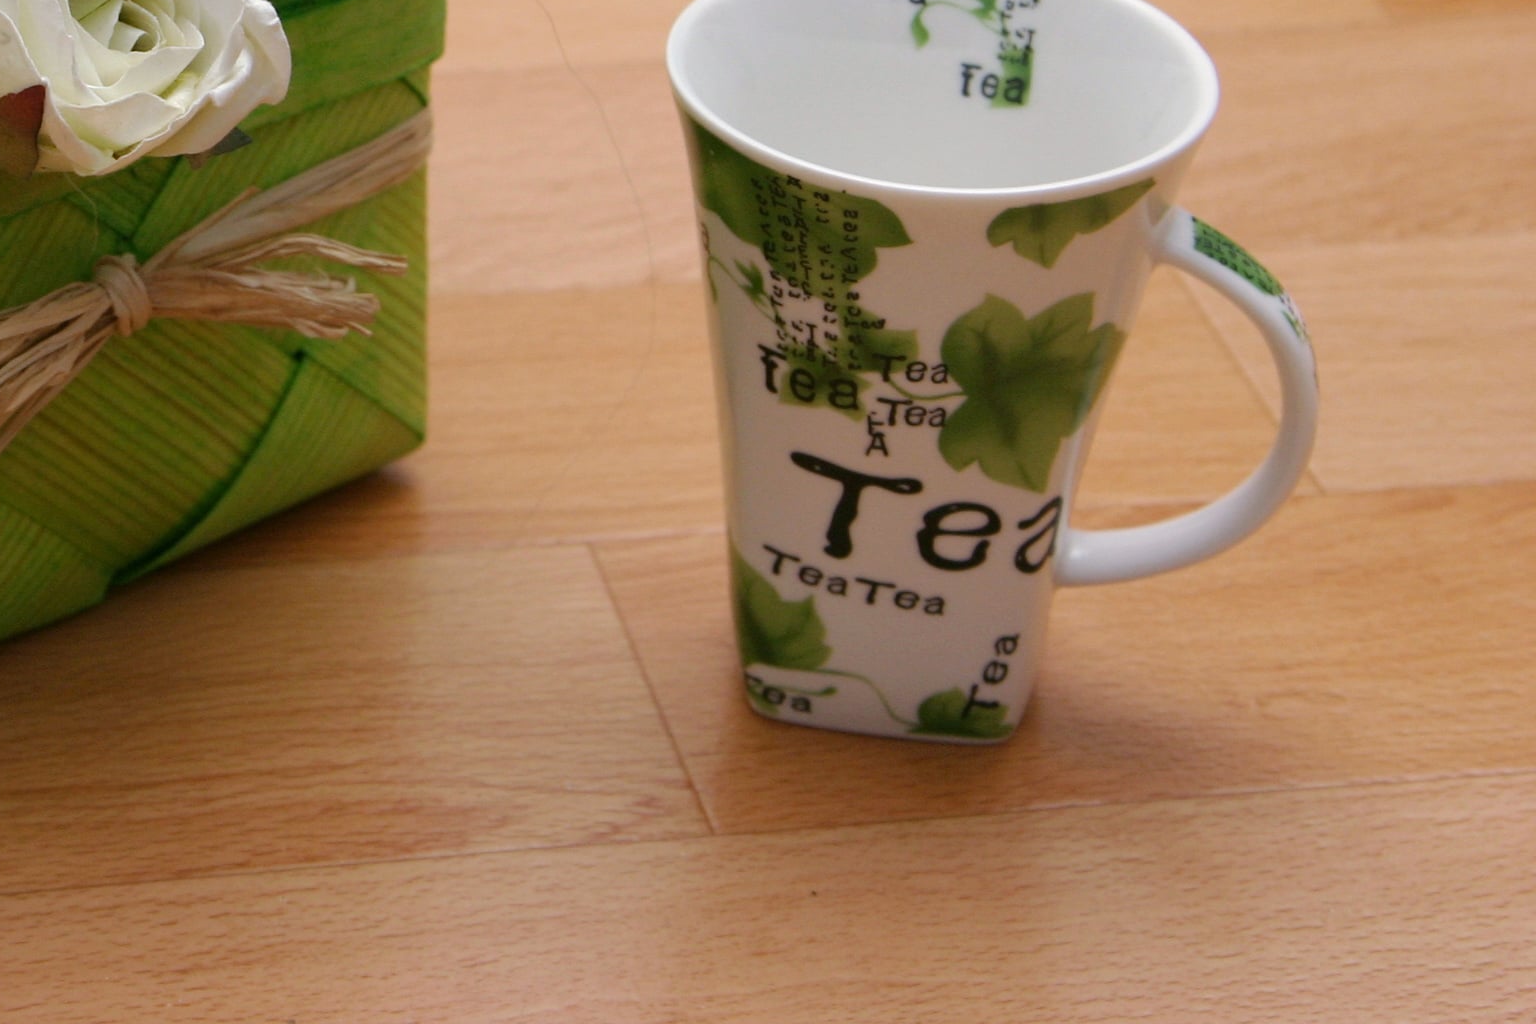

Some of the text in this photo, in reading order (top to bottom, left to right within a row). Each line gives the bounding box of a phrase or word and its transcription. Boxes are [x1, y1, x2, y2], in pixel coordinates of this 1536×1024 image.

[872, 353, 949, 384] Tea
[876, 397, 947, 427] Tea
[790, 451, 1062, 573] Tea
[960, 633, 1020, 719] Tea
